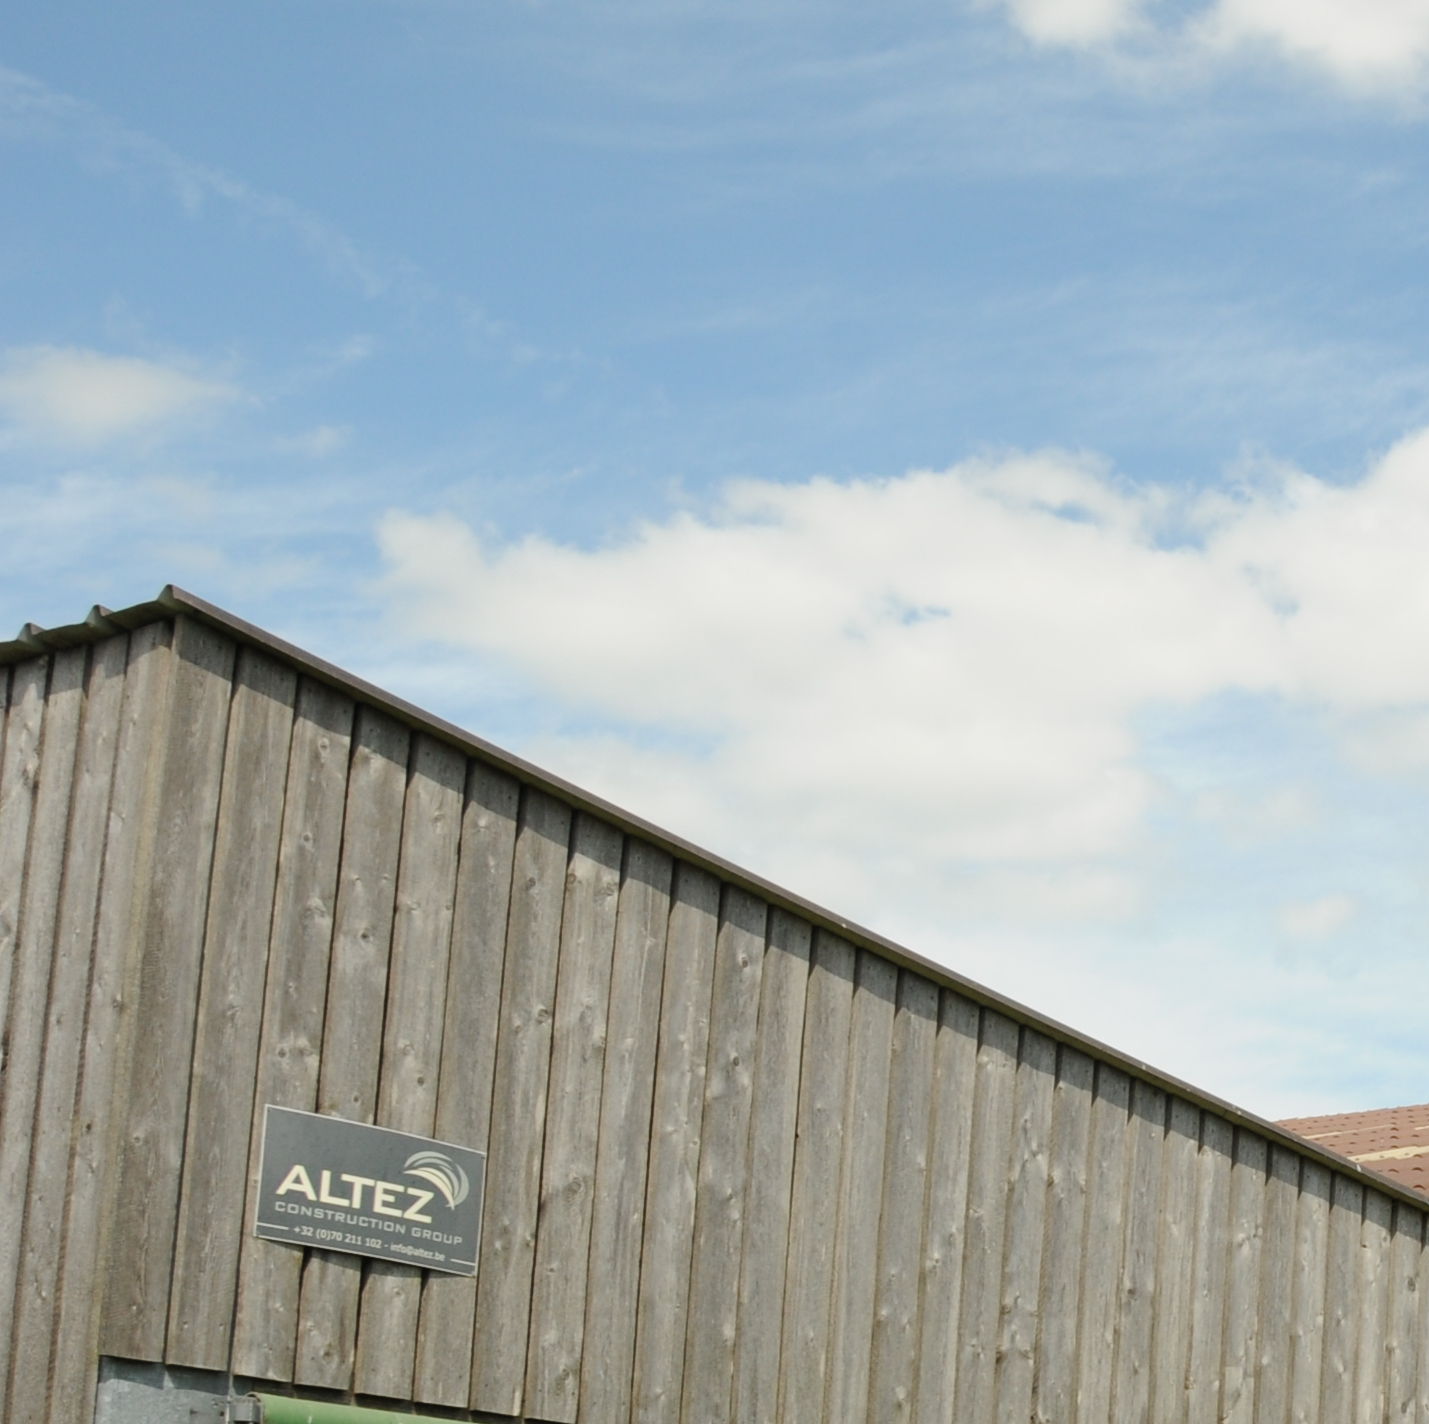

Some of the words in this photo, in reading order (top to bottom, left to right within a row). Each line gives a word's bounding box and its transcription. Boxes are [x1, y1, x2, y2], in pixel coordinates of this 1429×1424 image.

[275, 1165, 434, 1224] ALTEZ
[275, 1201, 406, 1234] CONSTRUCTION
[411, 1227, 463, 1246] GROUP
[293, 1225, 313, 1237] +32
[316, 1228, 343, 1241] (0)70
[344, 1234, 362, 1245] 211
